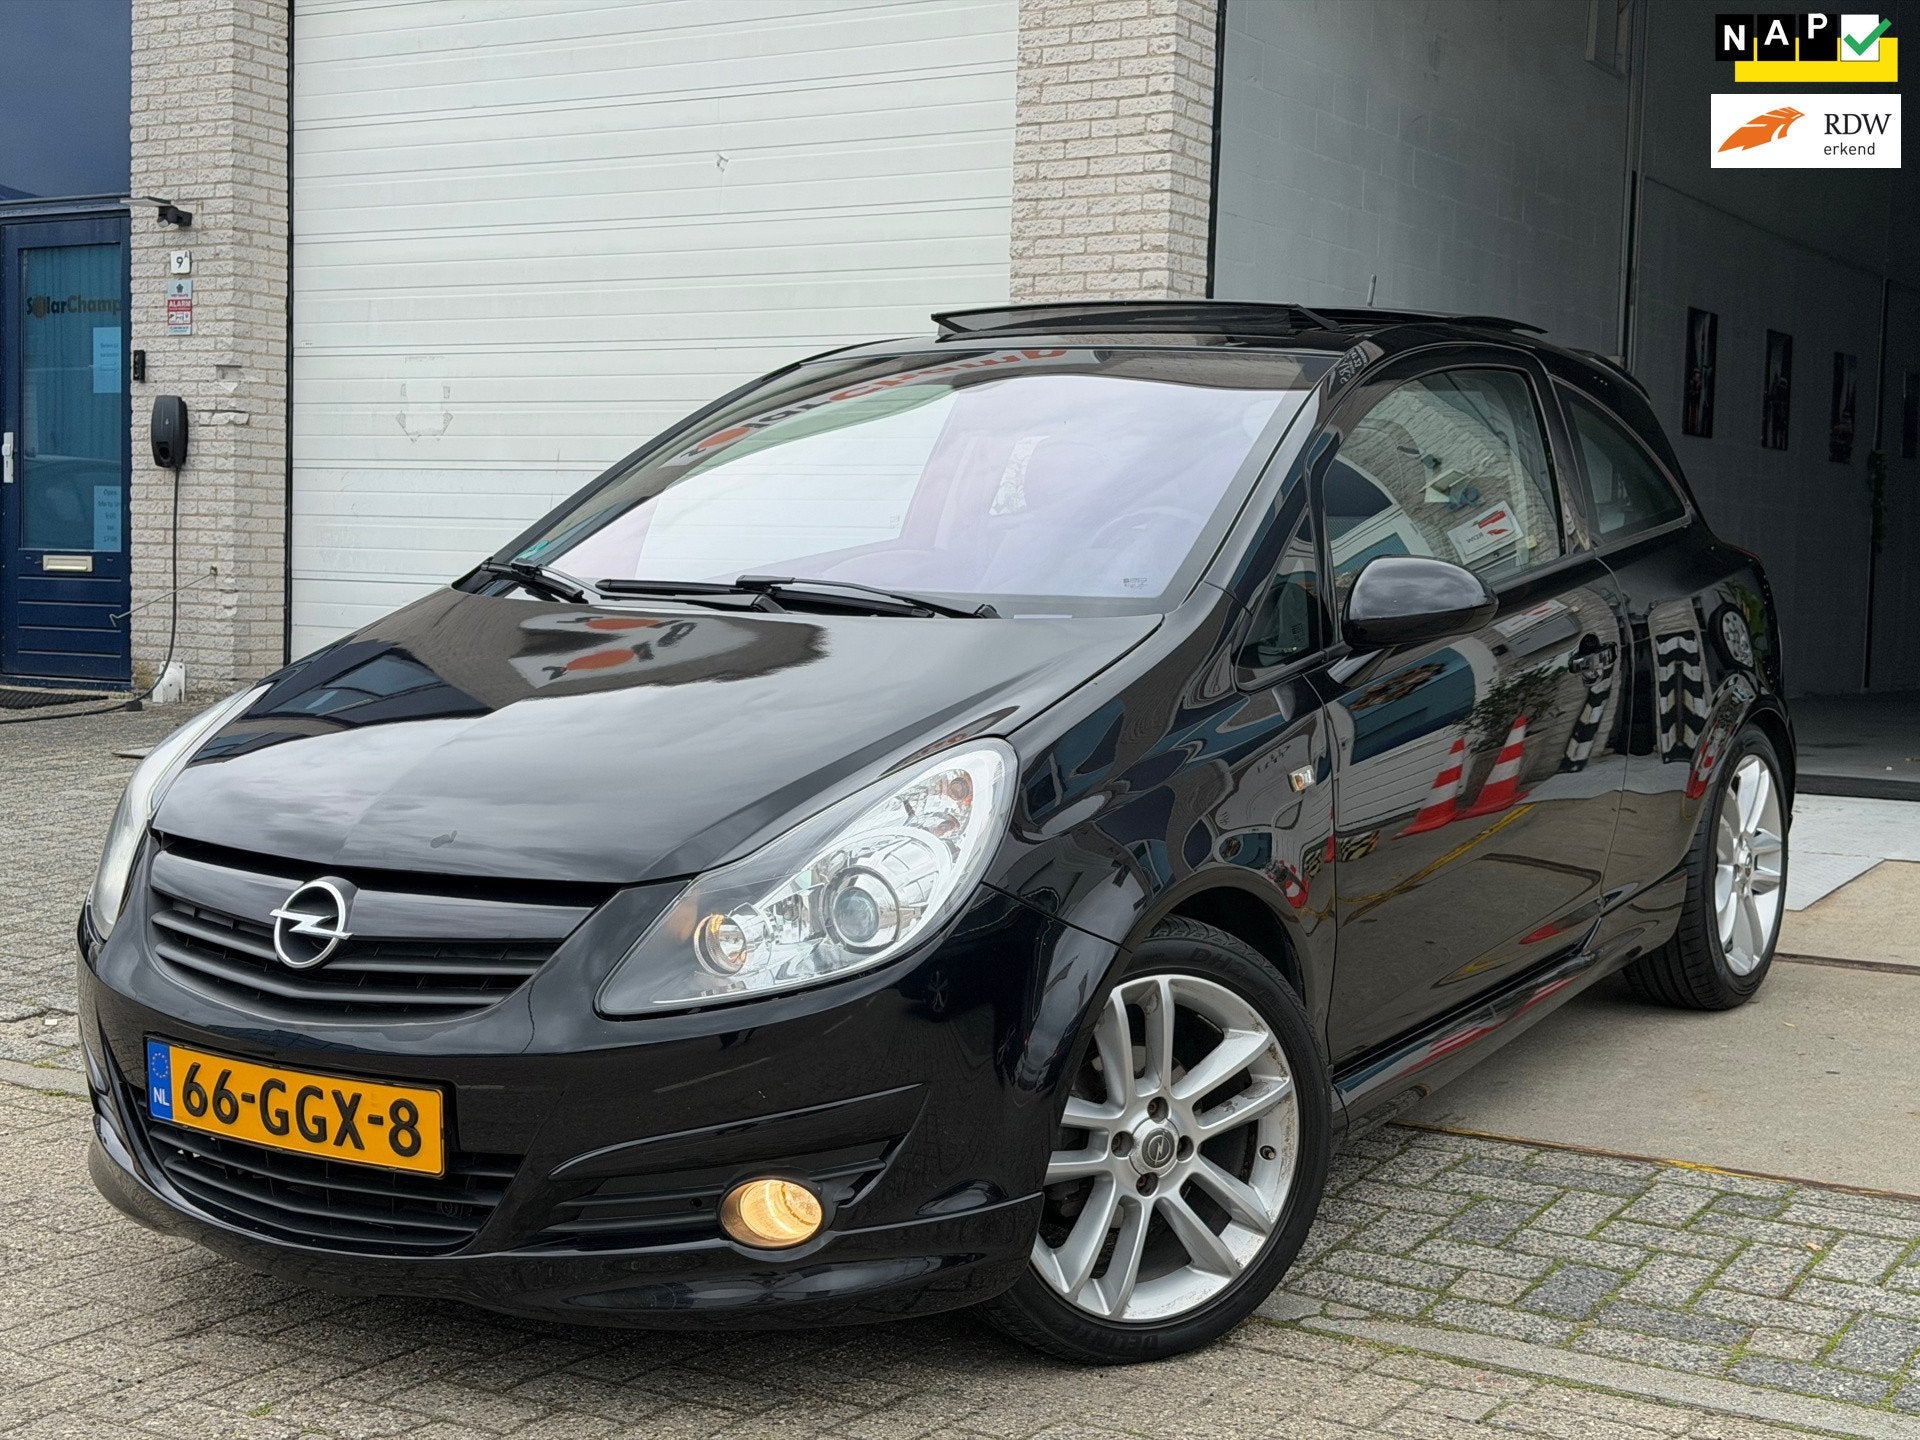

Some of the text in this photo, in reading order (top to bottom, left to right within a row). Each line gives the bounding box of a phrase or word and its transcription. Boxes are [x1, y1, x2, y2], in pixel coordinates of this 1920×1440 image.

[168, 300, 191, 309] ALARM
[153, 1086, 170, 1107] NL
[181, 1062, 422, 1158] 66-GGX-8
